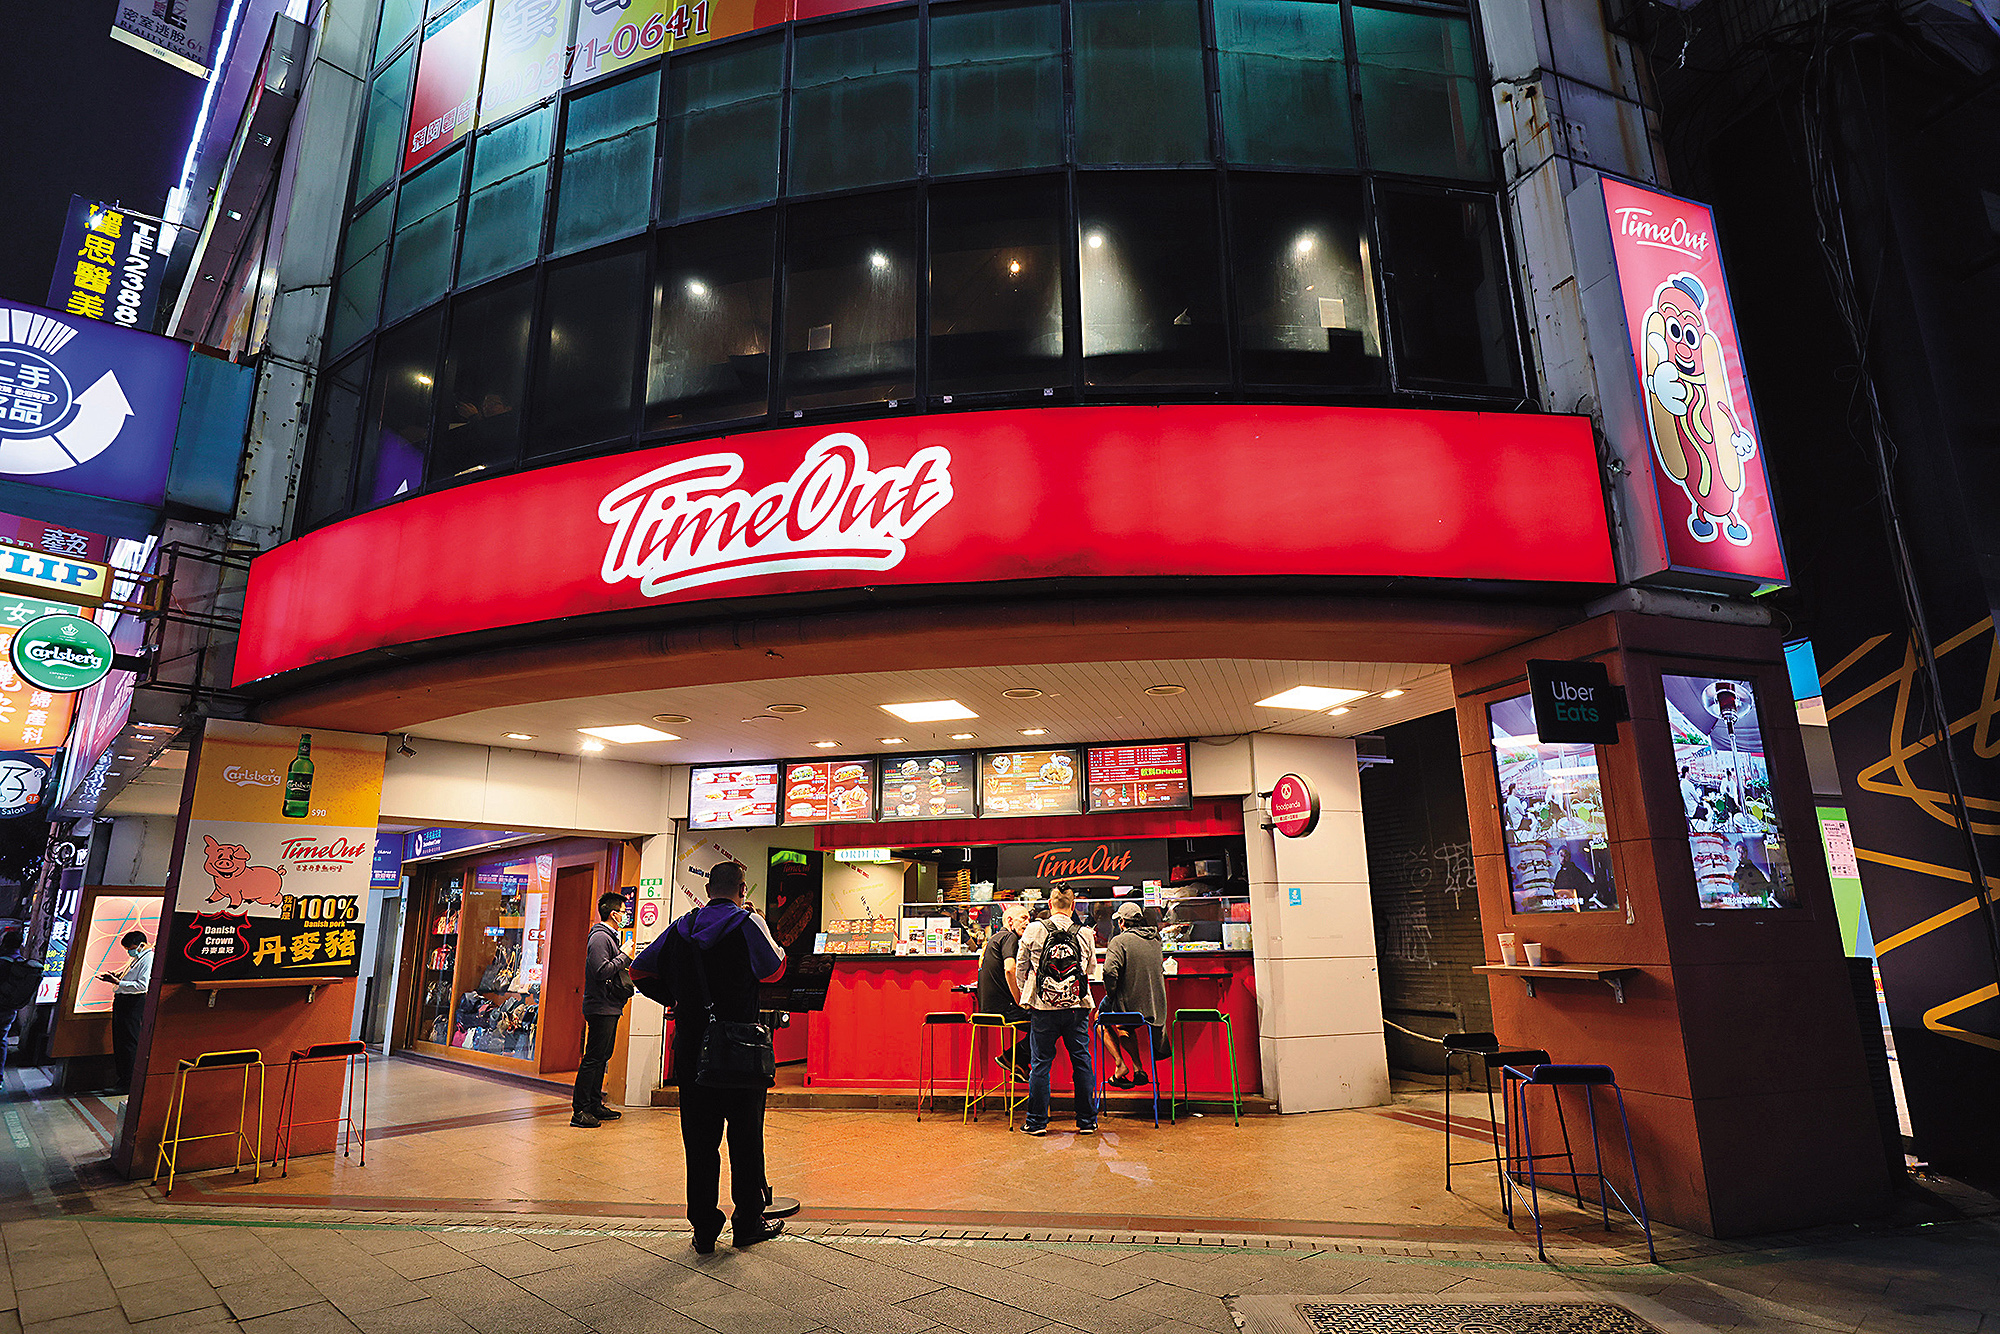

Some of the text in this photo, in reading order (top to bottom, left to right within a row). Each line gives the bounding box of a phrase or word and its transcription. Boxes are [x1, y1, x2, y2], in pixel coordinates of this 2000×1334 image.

[123, 7, 185, 45] 密室逃脫
[119, 20, 205, 62] REALITY ESCAPE
[1615, 207, 1710, 260] TimeOut
[598, 433, 954, 597] TimeOut
[0, 549, 98, 587] LIP
[24, 640, 104, 669] Carlsberg
[1551, 681, 1594, 701] Uber
[21, 691, 53, 744] 婦產科
[1555, 702, 1599, 722] Eats
[223, 765, 282, 787] Carlsberg
[2, 807, 26, 815] Salon
[312, 809, 327, 817] $90
[1275, 800, 1301, 811] foodpanda
[281, 837, 366, 863] TimeOut
[1034, 845, 1132, 883] TimeOut
[647, 886, 654, 897] 6
[298, 897, 354, 919] 100%
[204, 926, 236, 935] Danish
[304, 920, 346, 929] Danish pork
[205, 936, 234, 945] Crown
[253, 928, 356, 966] 丹麥豬
